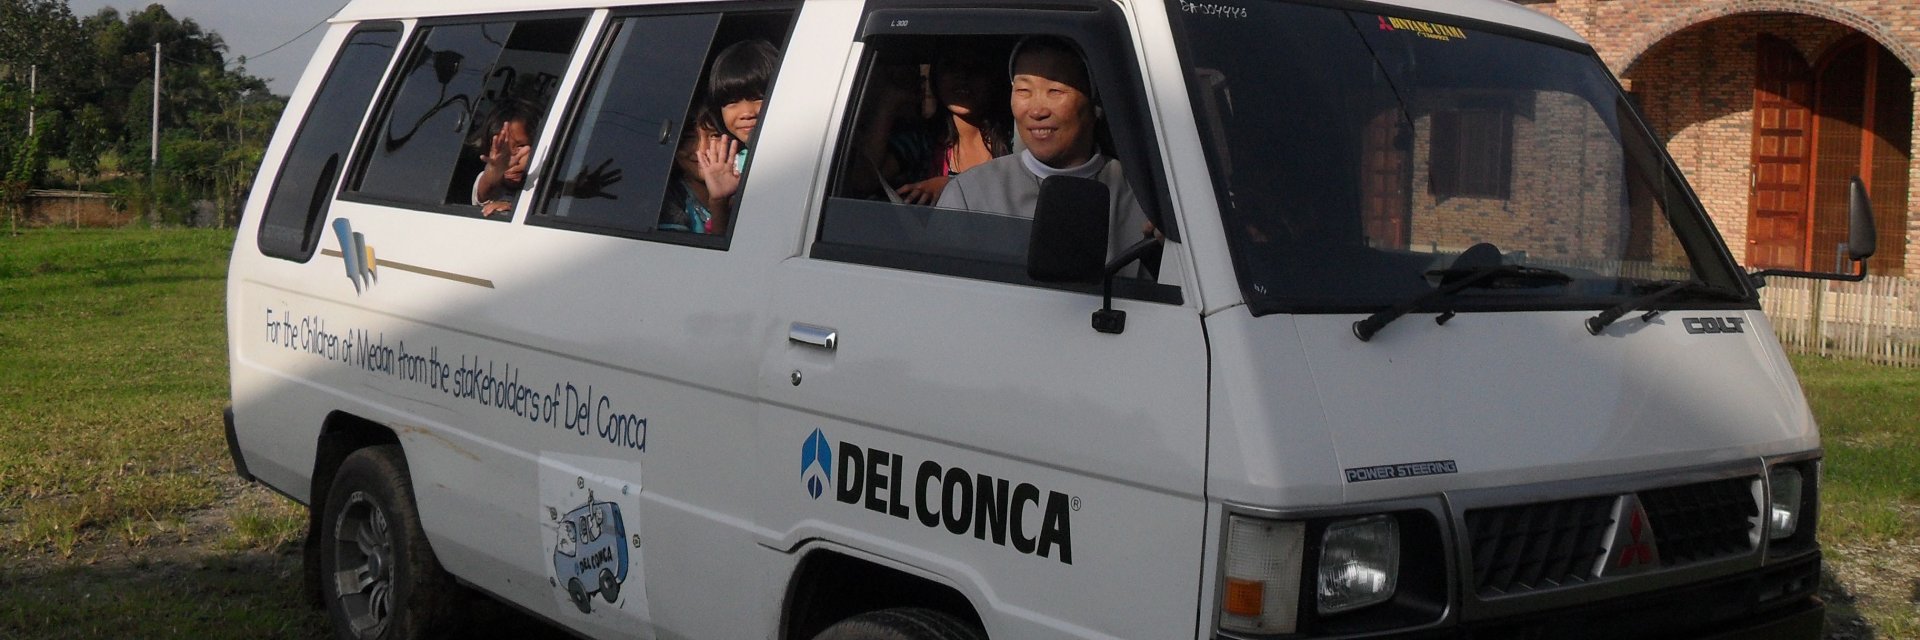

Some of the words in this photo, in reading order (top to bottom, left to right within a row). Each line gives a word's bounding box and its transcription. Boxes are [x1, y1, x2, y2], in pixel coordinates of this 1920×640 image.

[1388, 16, 1434, 34] BINTANG
[1430, 23, 1467, 39] UTAMA
[1682, 317, 1744, 335] COLT
[266, 308, 280, 344] For
[283, 311, 298, 350] the
[300, 315, 339, 360] Children
[342, 328, 353, 366] of
[356, 328, 394, 375] Medan
[398, 340, 427, 384] from
[429, 345, 450, 393] the
[453, 354, 540, 421] stakeholders
[543, 382, 560, 429] of
[564, 381, 592, 436] Del
[597, 395, 647, 453] Conca
[836, 441, 910, 520] DEL
[1346, 465, 1395, 481] POWER
[1397, 461, 1457, 477] STEERING
[579, 557, 592, 574] DEL
[591, 545, 613, 570] CONCA
